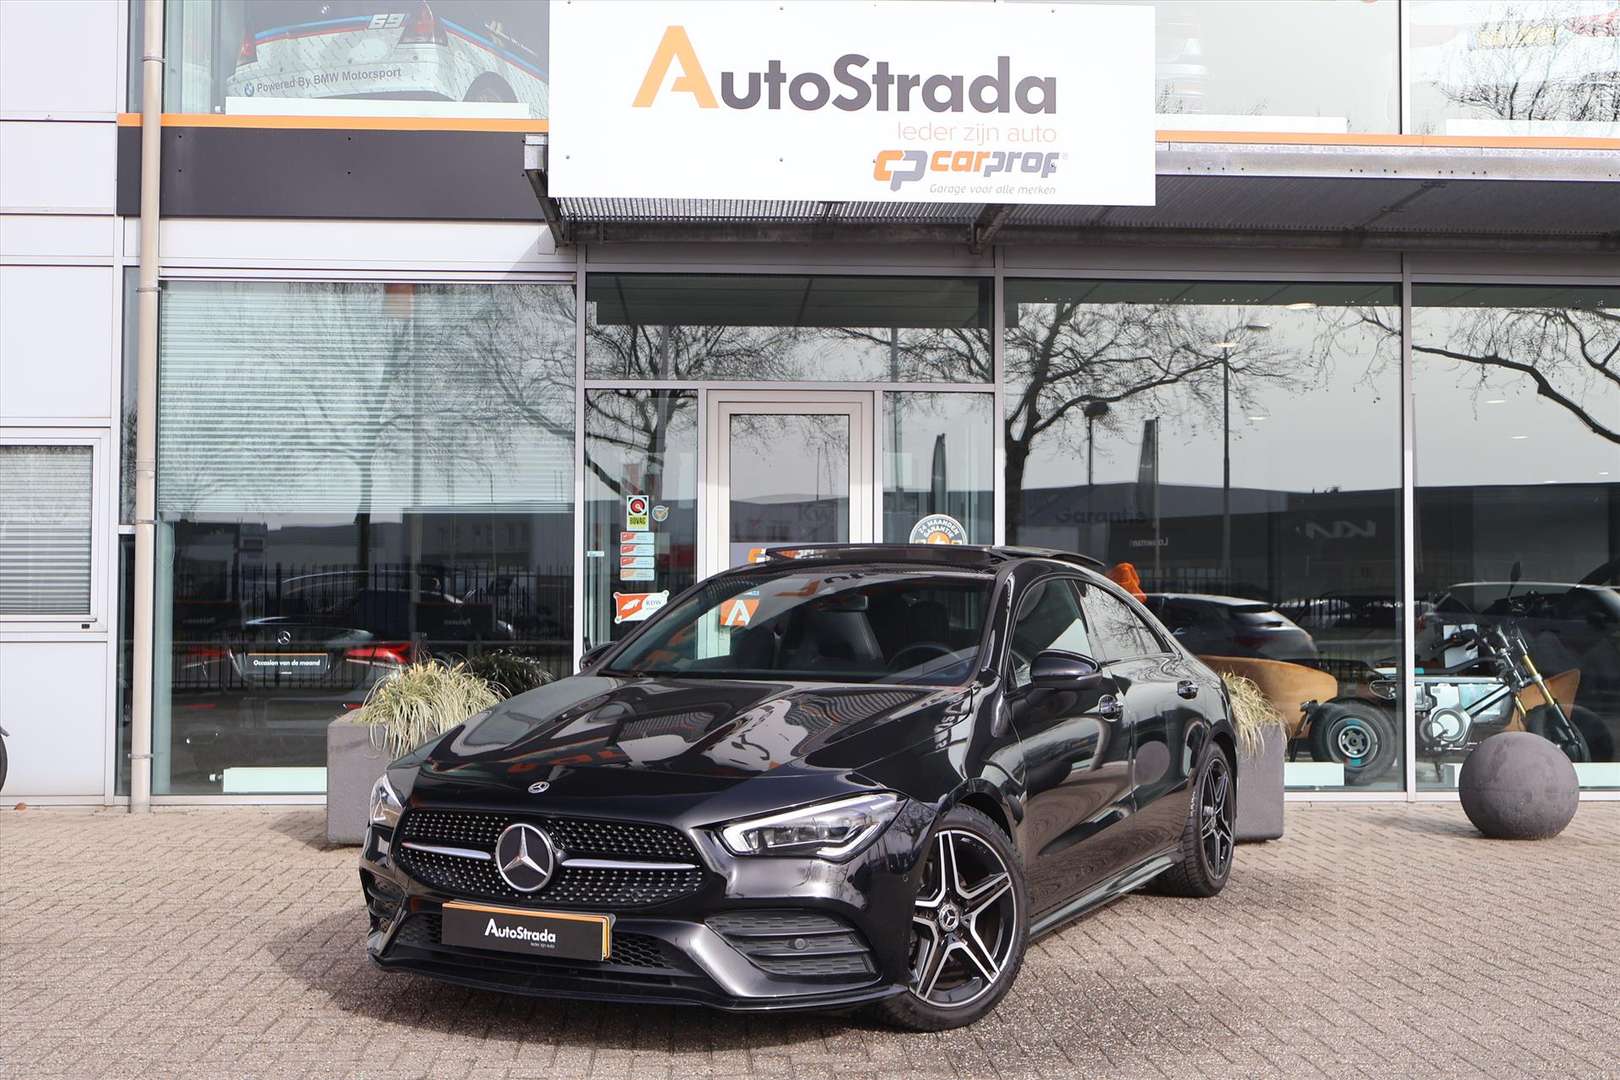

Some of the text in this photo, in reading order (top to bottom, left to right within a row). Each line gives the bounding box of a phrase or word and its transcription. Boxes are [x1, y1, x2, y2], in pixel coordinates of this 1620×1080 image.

[369, 14, 405, 29] 69
[257, 67, 401, 93] Powered By BMW Motorsport
[632, 25, 1056, 114] AutoStrada
[898, 122, 1057, 145] Ieder zijn auto
[929, 184, 1057, 195] Garage voor alle merken
[484, 918, 556, 943] AutoStrada
